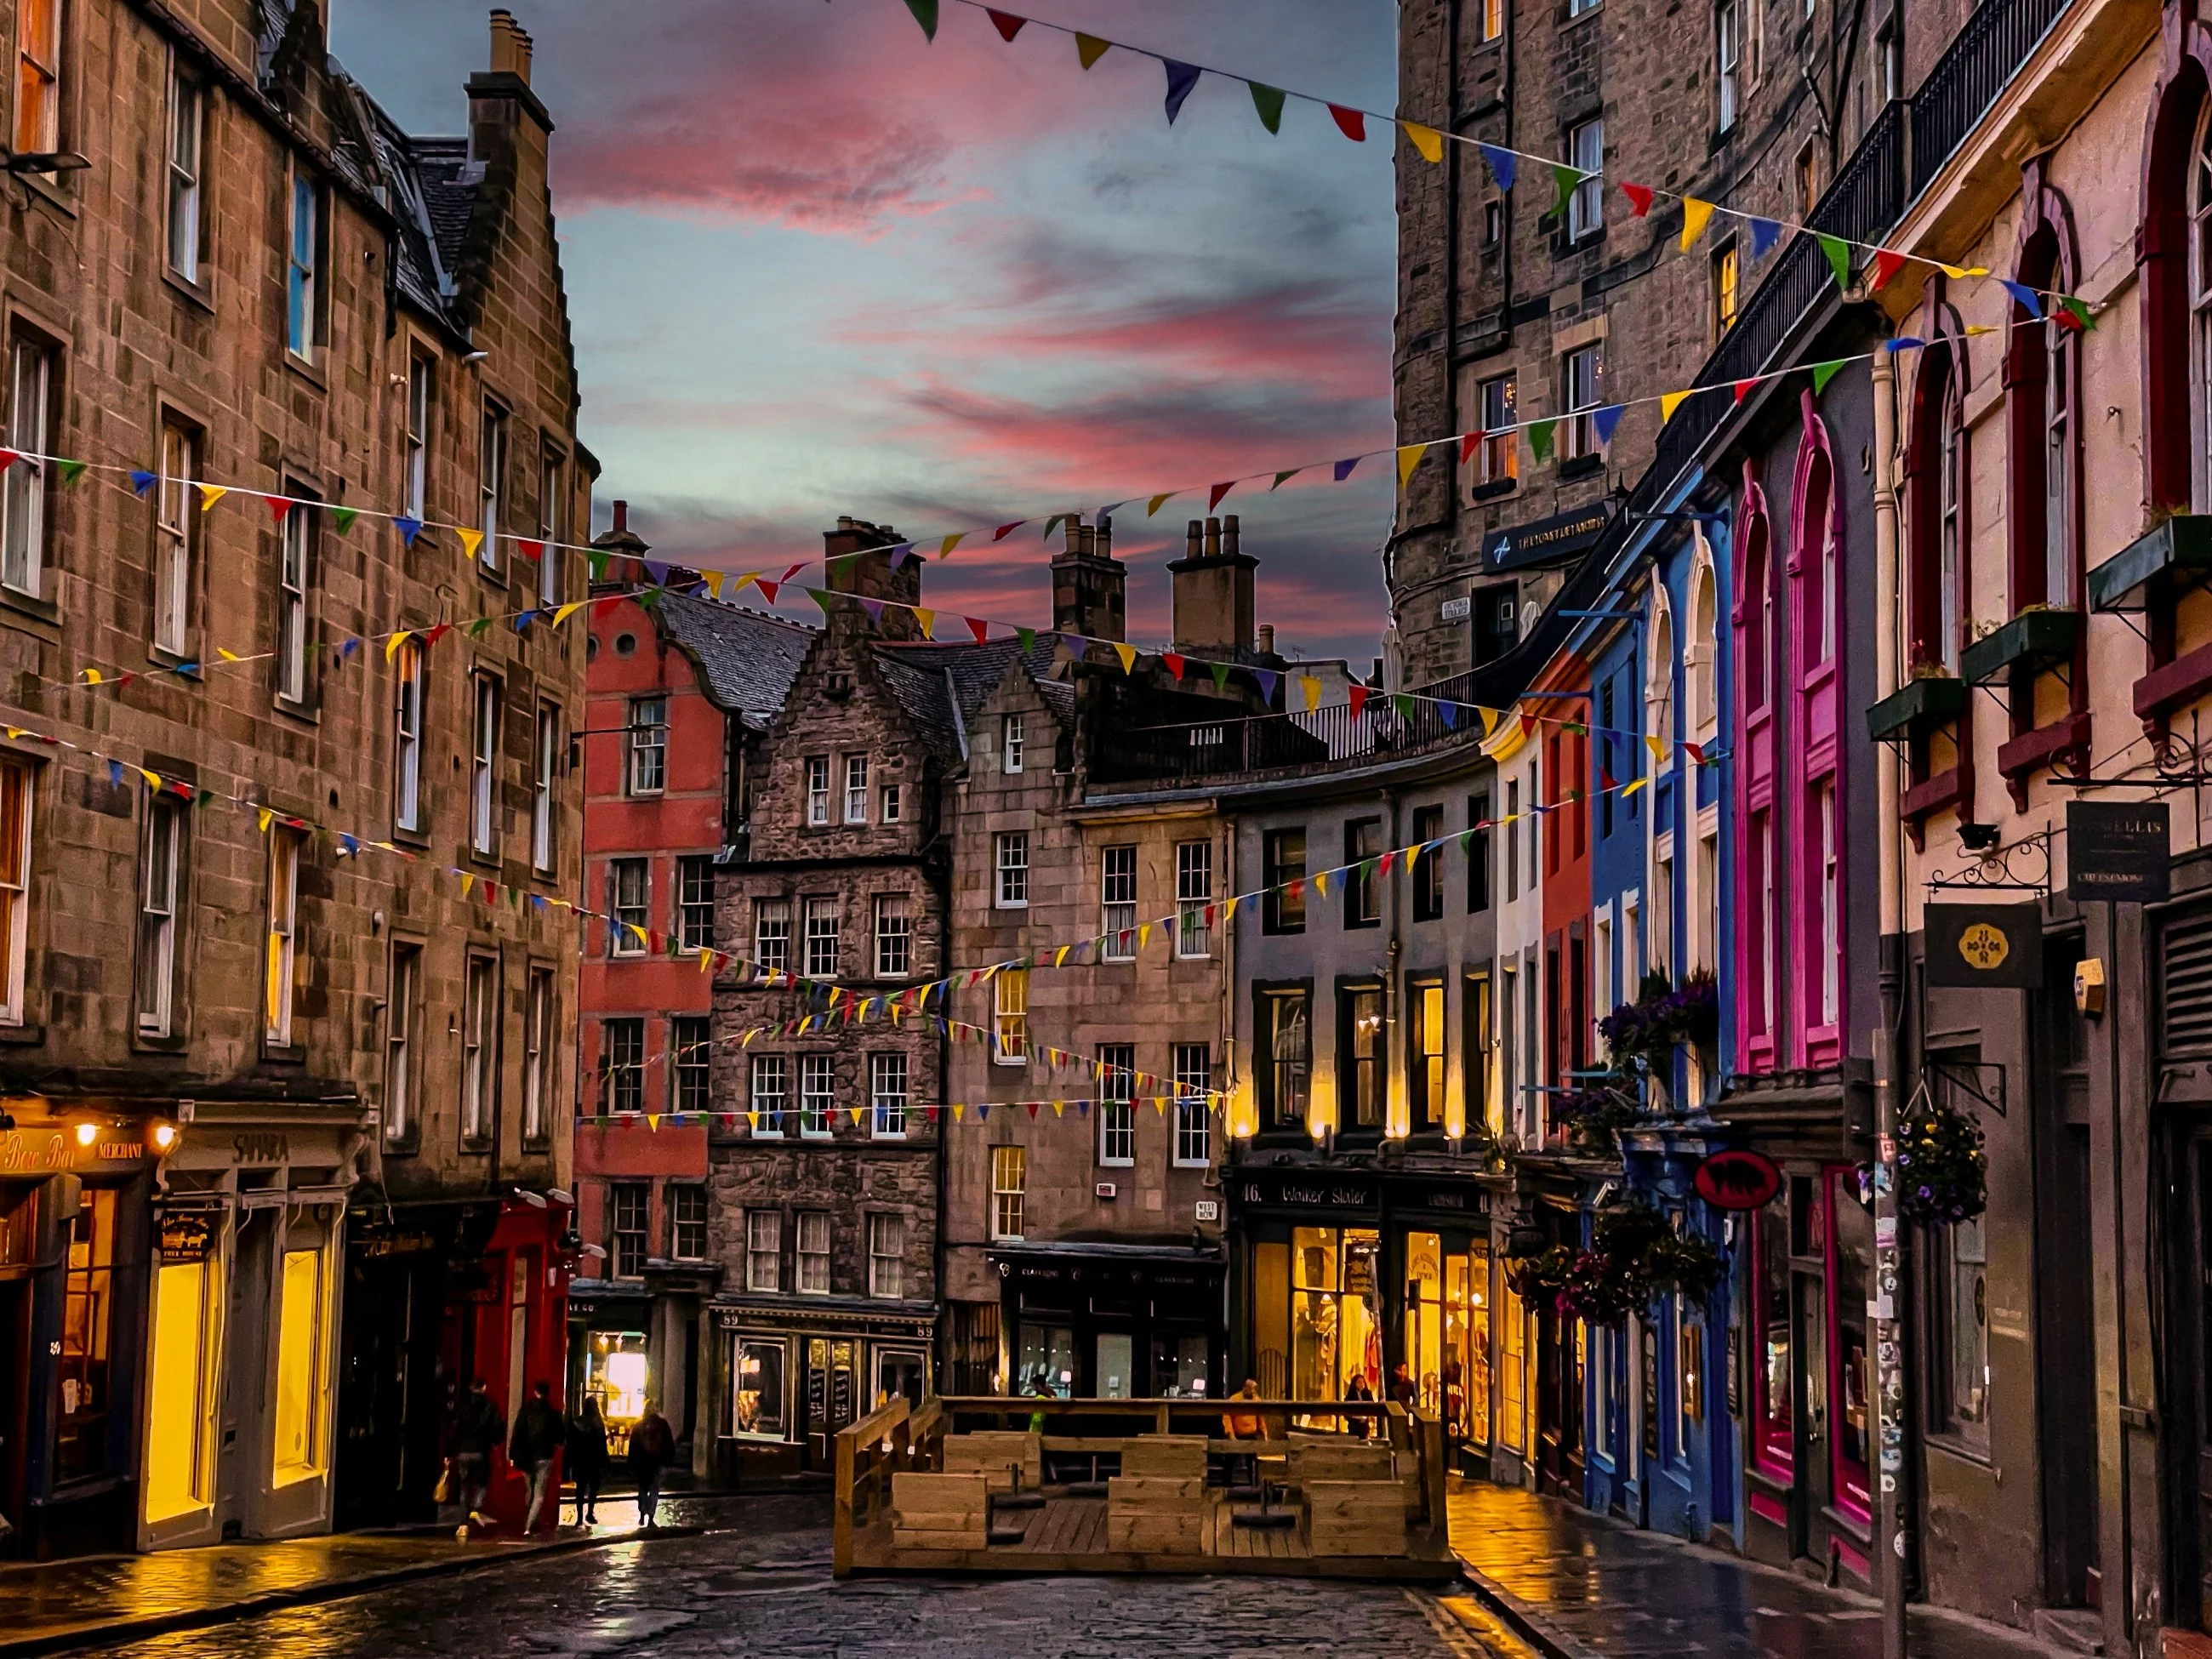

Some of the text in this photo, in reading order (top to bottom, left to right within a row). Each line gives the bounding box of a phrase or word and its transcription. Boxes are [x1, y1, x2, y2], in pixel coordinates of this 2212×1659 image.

[1444, 598, 1468, 610] VICTORIA
[4, 1134, 40, 1170] Bow
[99, 1143, 143, 1159] MERCHANT
[1283, 1186, 1325, 1203] Walker
[1332, 1186, 1367, 1205] Slater
[1199, 1203, 1215, 1211] WEST
[724, 1314, 738, 1325] 89
[917, 1326, 933, 1337] 89
